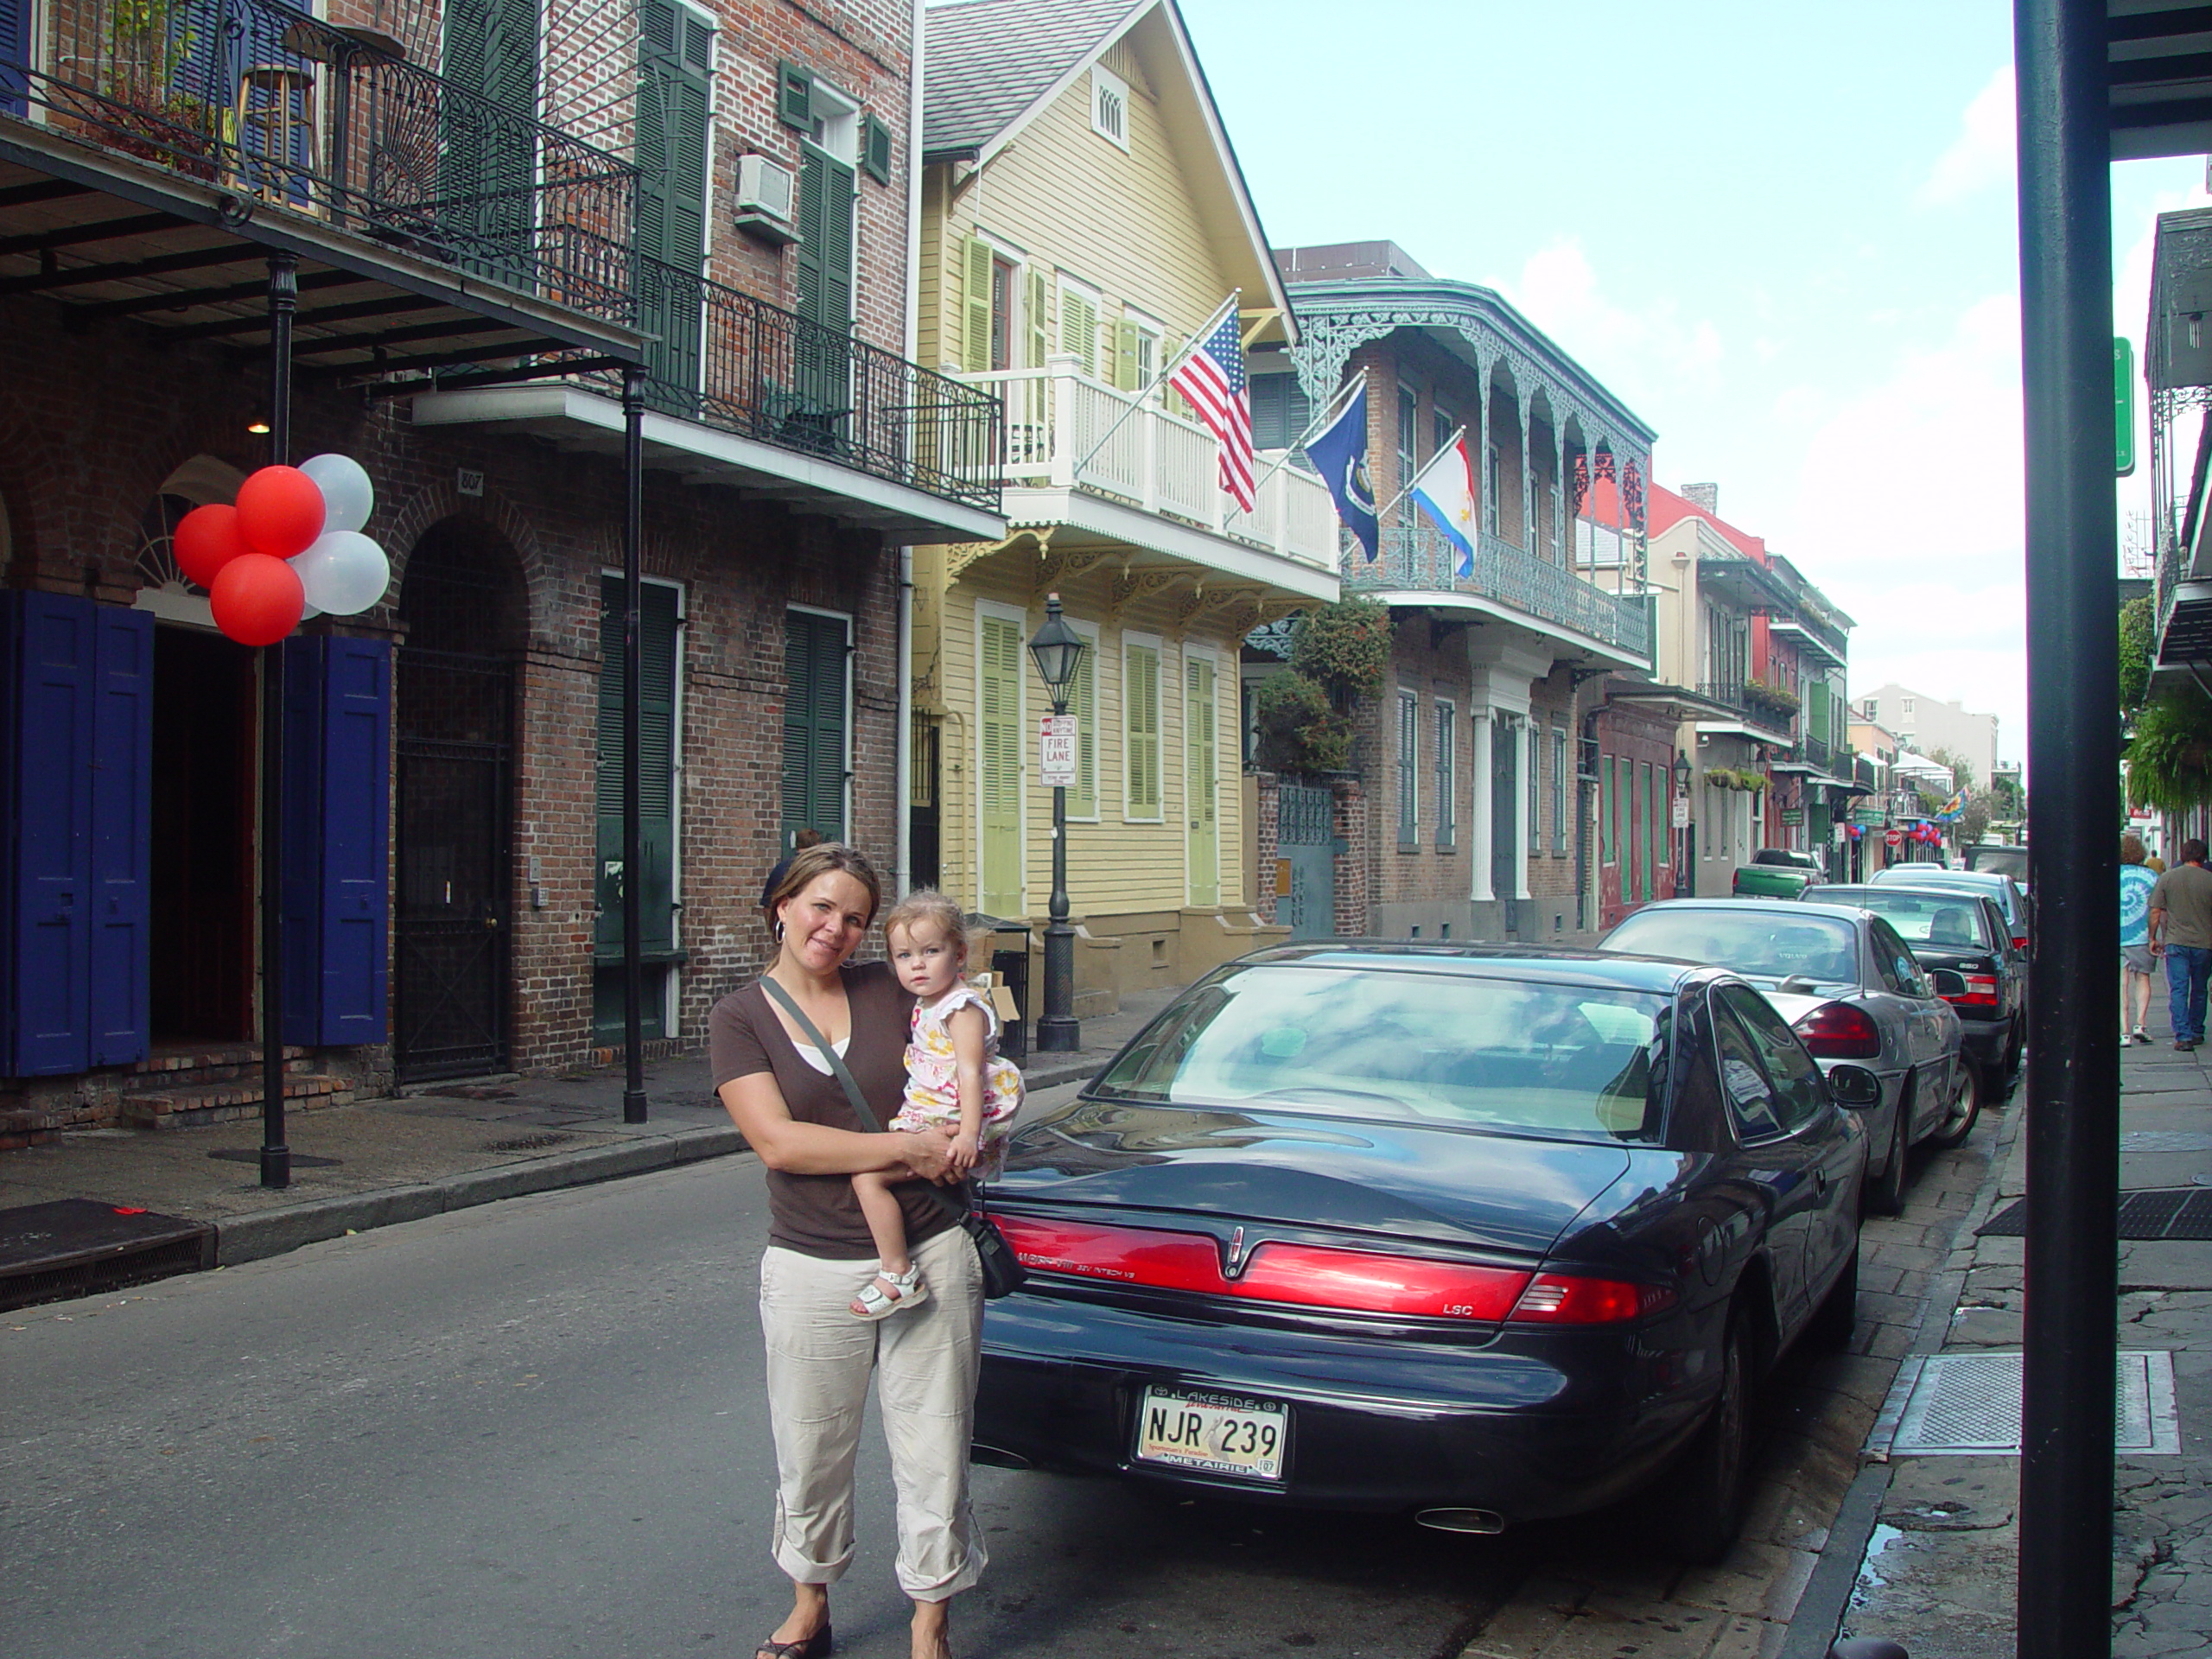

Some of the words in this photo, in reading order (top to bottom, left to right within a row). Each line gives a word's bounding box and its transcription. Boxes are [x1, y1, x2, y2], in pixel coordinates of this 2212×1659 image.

[461, 473, 481, 490] 807
[1048, 738, 1069, 749] FIRE
[1046, 751, 1071, 762] LANE
[1443, 1304, 1473, 1315] LSC
[1148, 1407, 1202, 1447] NJR
[1221, 1419, 1277, 1457] 239
[1169, 1455, 1247, 1473] METAIRIE
[1262, 1462, 1274, 1472] 07
